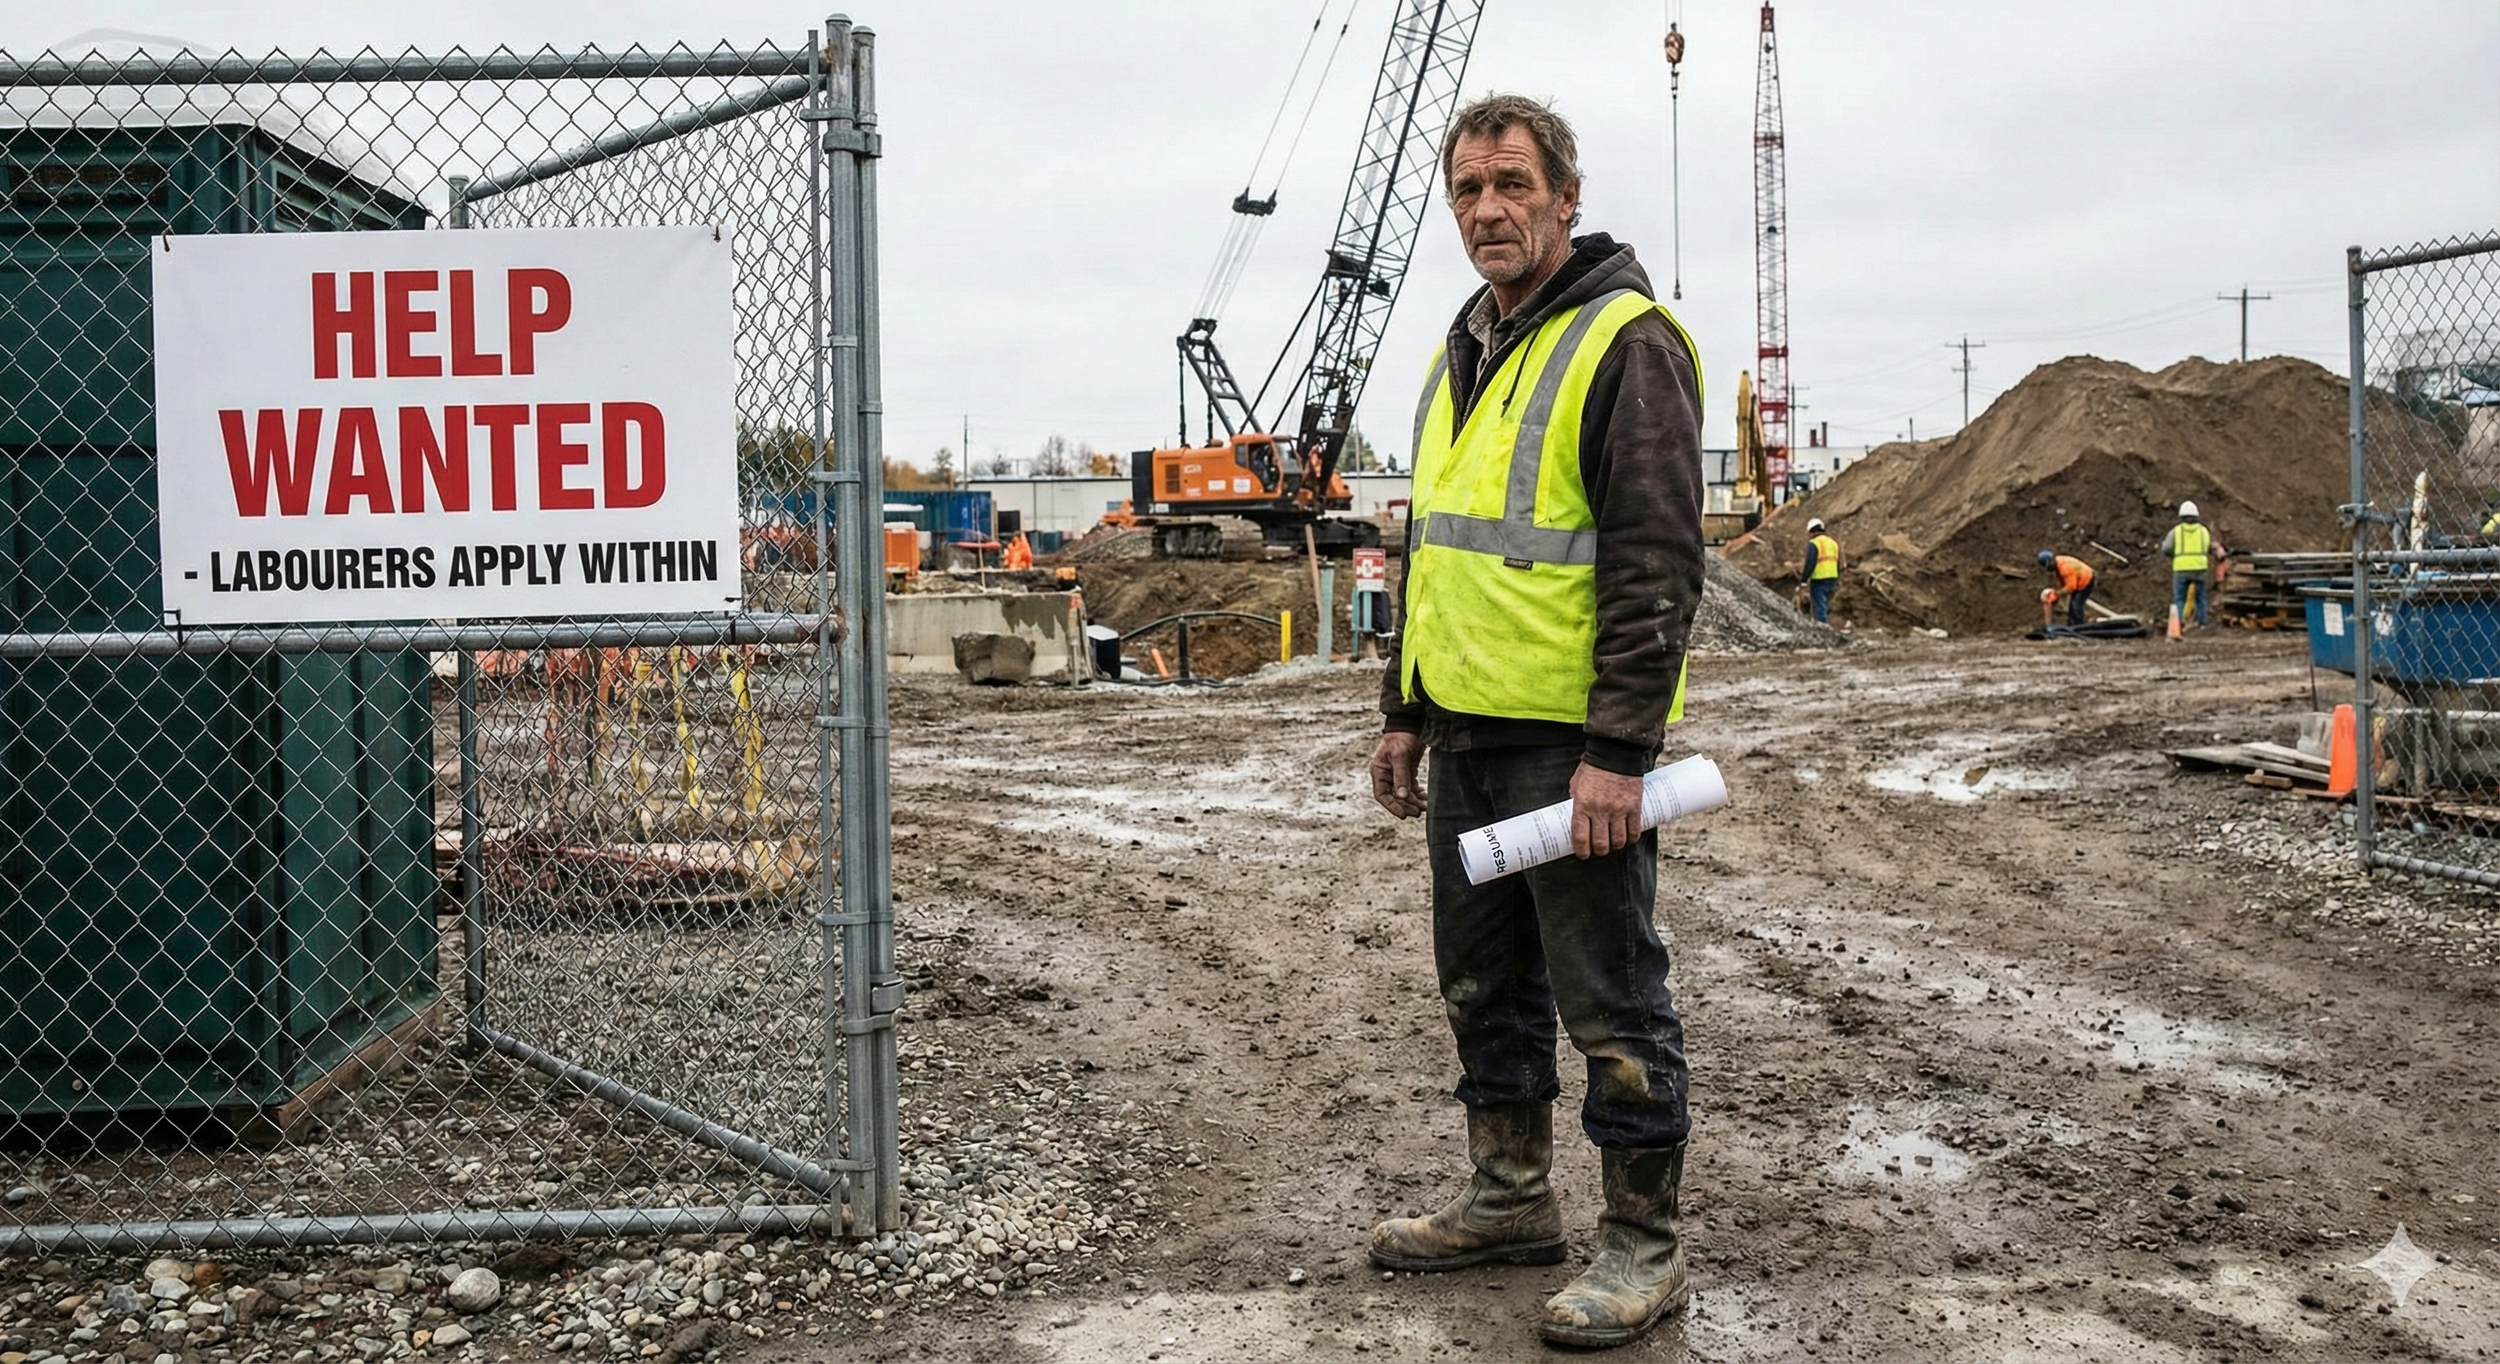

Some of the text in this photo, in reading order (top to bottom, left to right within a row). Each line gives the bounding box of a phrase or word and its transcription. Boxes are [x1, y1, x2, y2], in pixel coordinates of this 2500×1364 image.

[312, 268, 572, 379] HELP
[218, 401, 667, 517] WANTED
[210, 546, 436, 593] LABOURERS
[448, 543, 567, 587] APPLY
[578, 540, 718, 584] WITHIN
[1482, 826, 1507, 874] RESUME
